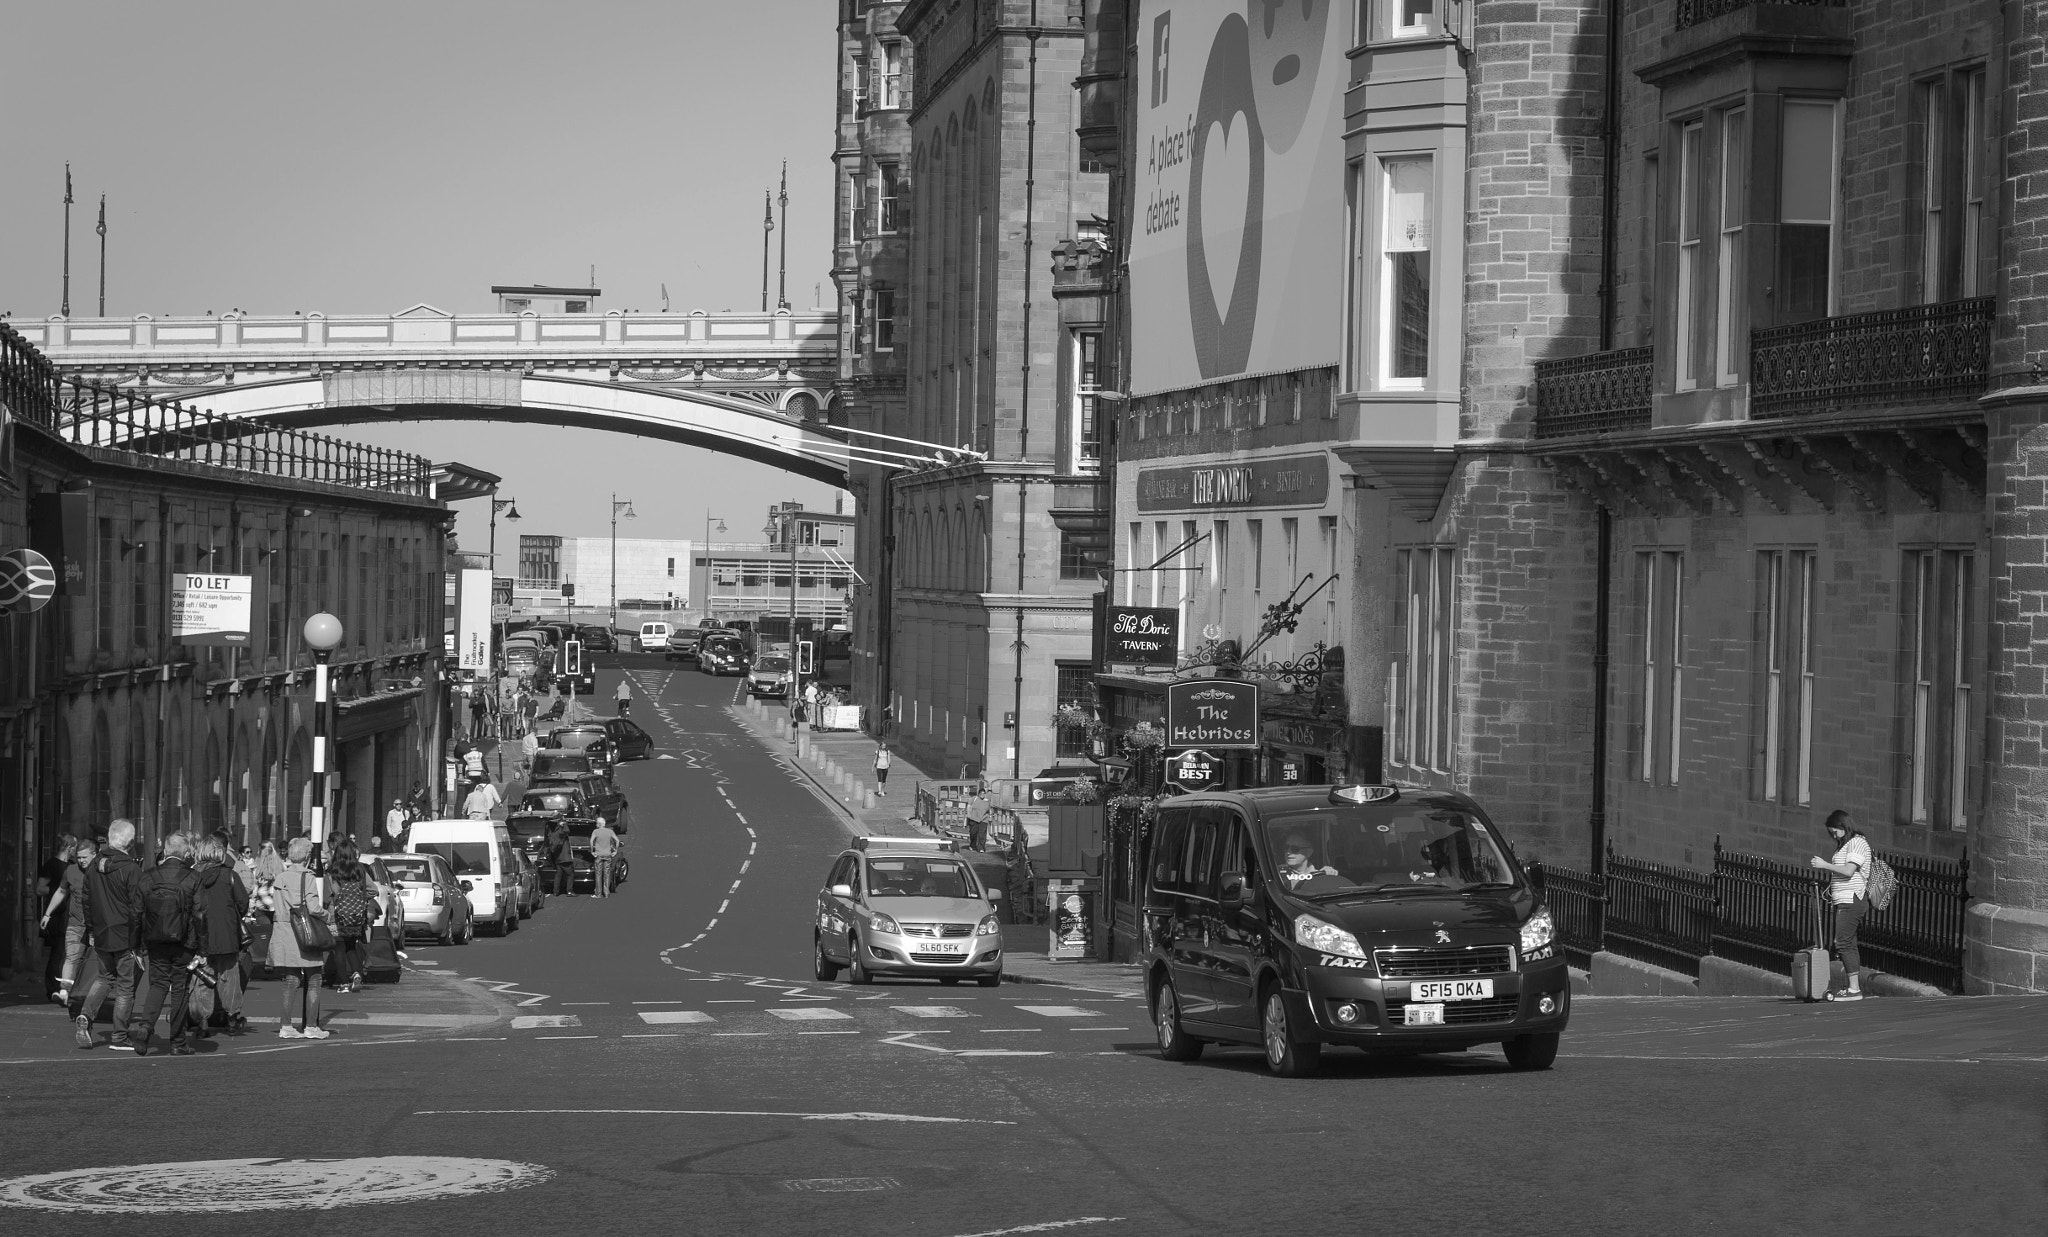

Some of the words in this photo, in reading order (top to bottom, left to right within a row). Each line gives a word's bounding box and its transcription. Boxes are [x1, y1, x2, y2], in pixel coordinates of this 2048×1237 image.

[1148, 134, 1156, 175] A
[1158, 125, 1184, 185] place
[1146, 188, 1180, 236] debate
[1192, 470, 1214, 504] THE
[1216, 468, 1252, 502] DORIC
[1276, 471, 1302, 492] BISTRO
[186, 576, 202, 588] TO
[208, 578, 230, 590] LET
[1114, 614, 1138, 633] The
[1138, 614, 1170, 634] Doric
[1122, 640, 1159, 650] TAVERN
[1196, 705, 1228, 720] The
[1174, 724, 1251, 740] Hebrides
[1179, 768, 1212, 780] BEST
[1320, 954, 1368, 968] TAXI
[1522, 946, 1553, 962] TAXI
[1420, 984, 1452, 997] SF15
[1456, 982, 1483, 996] OKA
